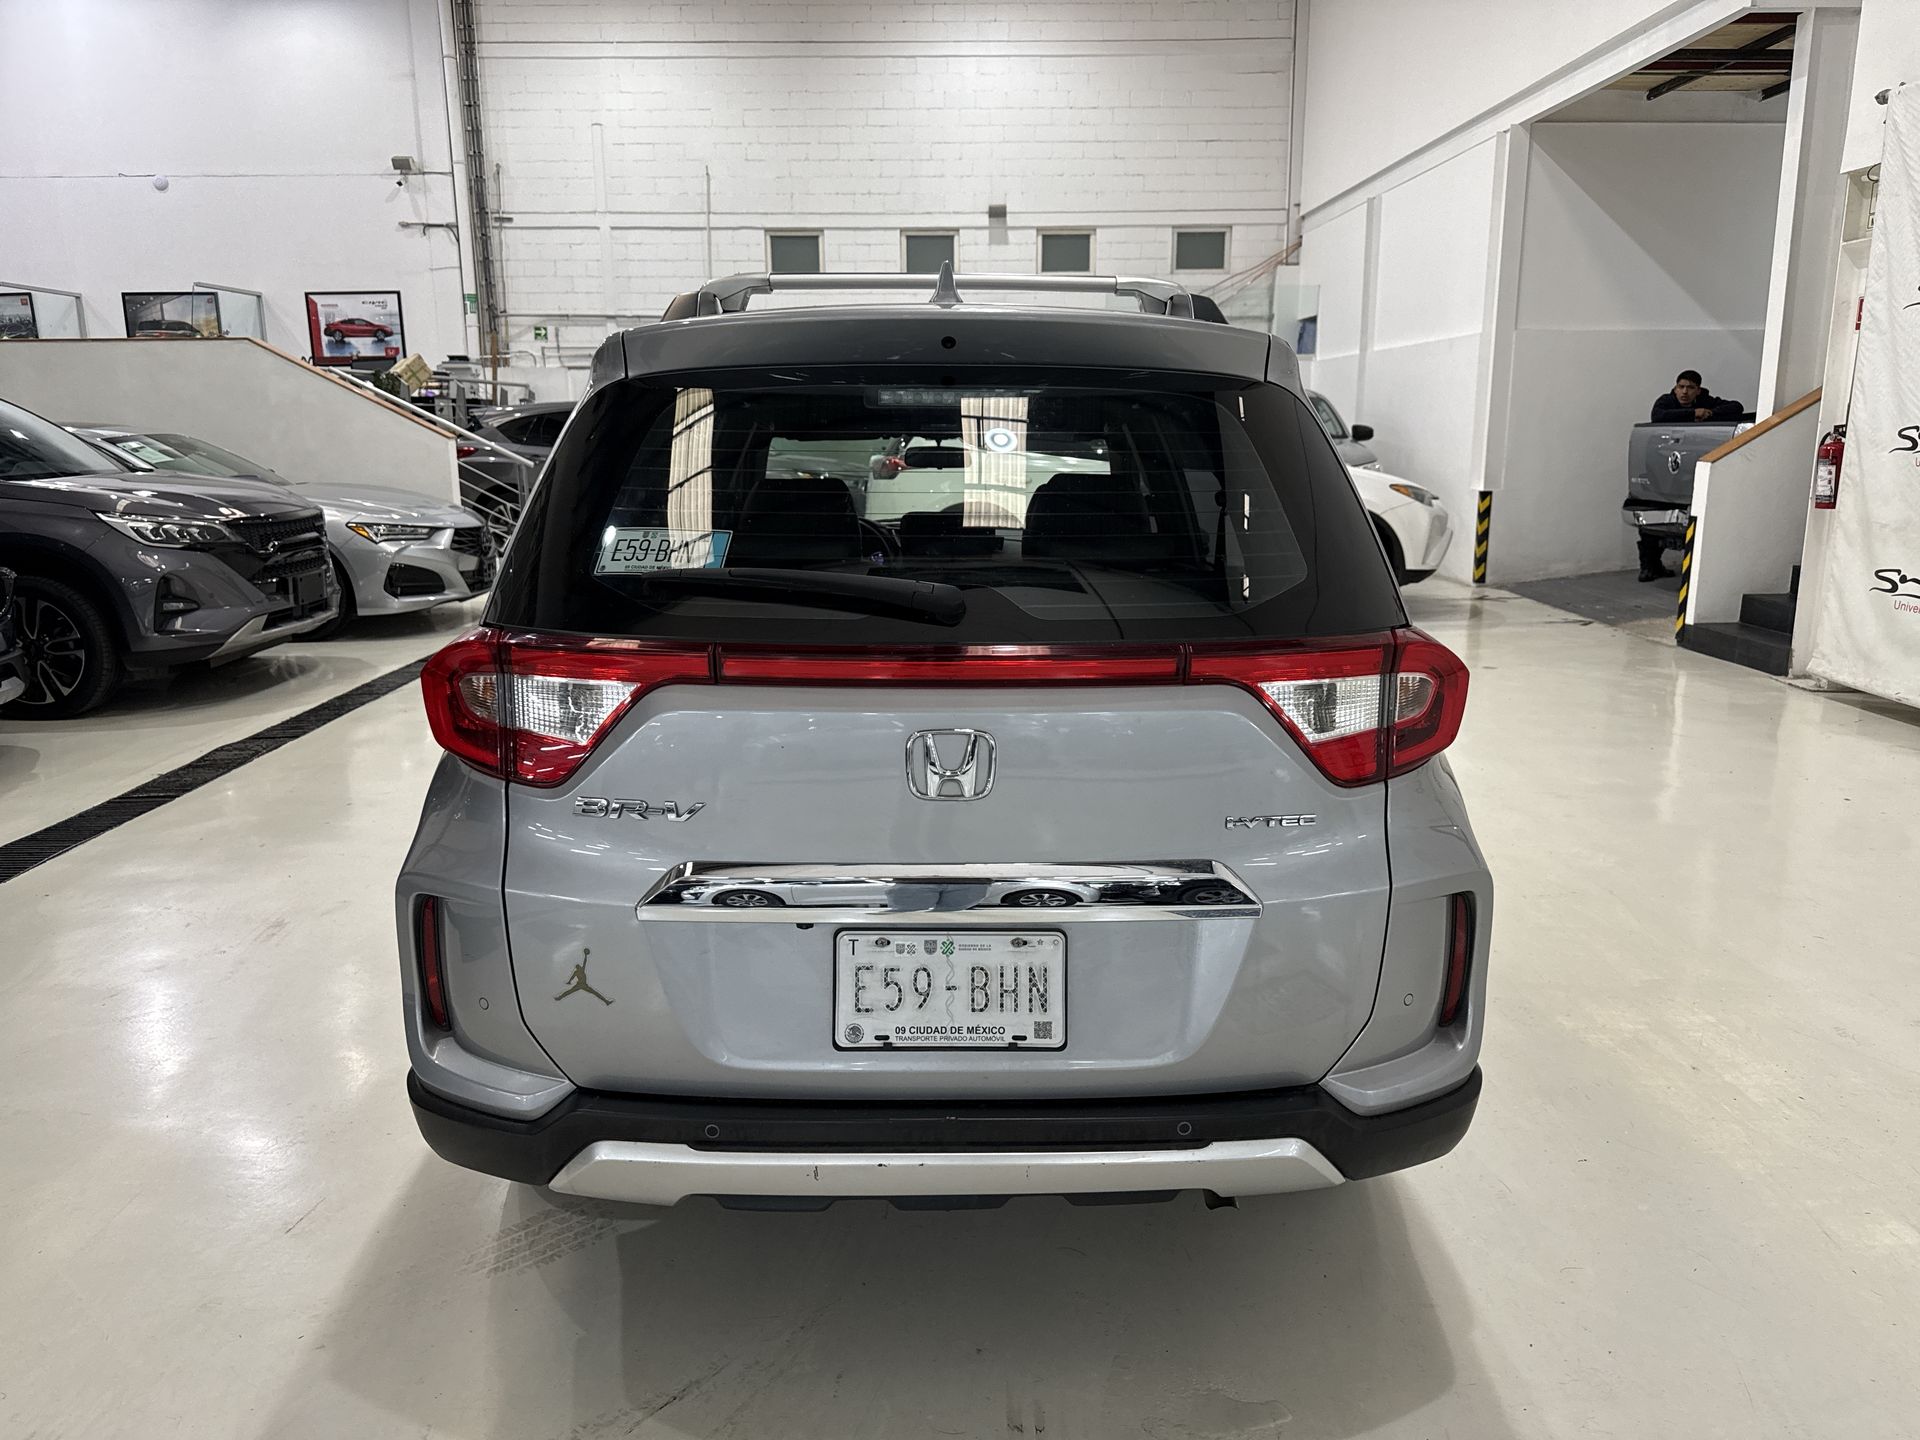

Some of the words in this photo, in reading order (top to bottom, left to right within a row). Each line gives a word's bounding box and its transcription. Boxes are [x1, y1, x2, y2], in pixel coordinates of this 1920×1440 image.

[611, 539, 696, 563] E59-BHN
[573, 796, 706, 823] BR-V
[848, 939, 859, 955] T
[895, 1026, 906, 1035] 09
[909, 1026, 947, 1035] CIUDAD
[950, 1026, 963, 1035] DE
[966, 1024, 1006, 1035] MÉXICO
